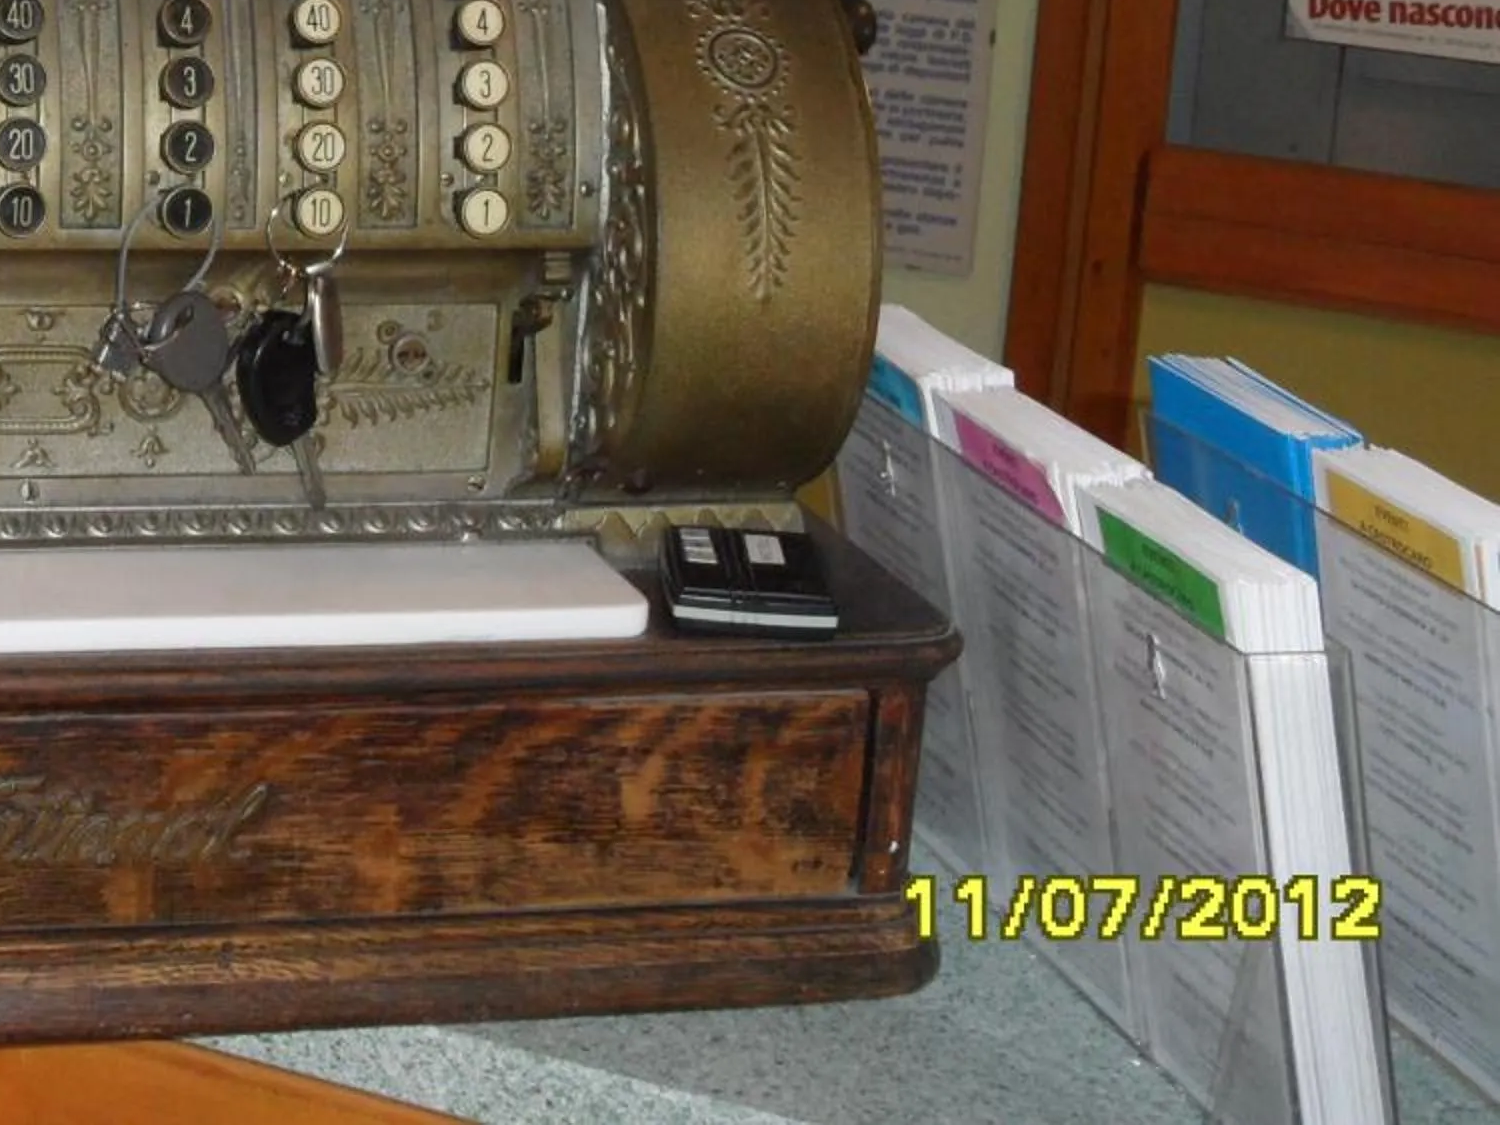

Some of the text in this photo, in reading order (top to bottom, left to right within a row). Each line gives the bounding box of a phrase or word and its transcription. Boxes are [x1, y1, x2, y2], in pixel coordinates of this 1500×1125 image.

[6, 0, 33, 29] 40
[181, 5, 193, 35] 4
[306, 2, 331, 33] 40
[476, 6, 489, 37] 4
[9, 62, 35, 95] 30
[183, 65, 197, 97] 3
[311, 65, 336, 97] 30
[479, 69, 492, 99] 3
[9, 127, 34, 160] 20
[184, 131, 198, 163] 2
[312, 131, 336, 162] 20
[481, 131, 494, 162] 2
[11, 195, 33, 228] 10
[311, 197, 332, 229] 10
